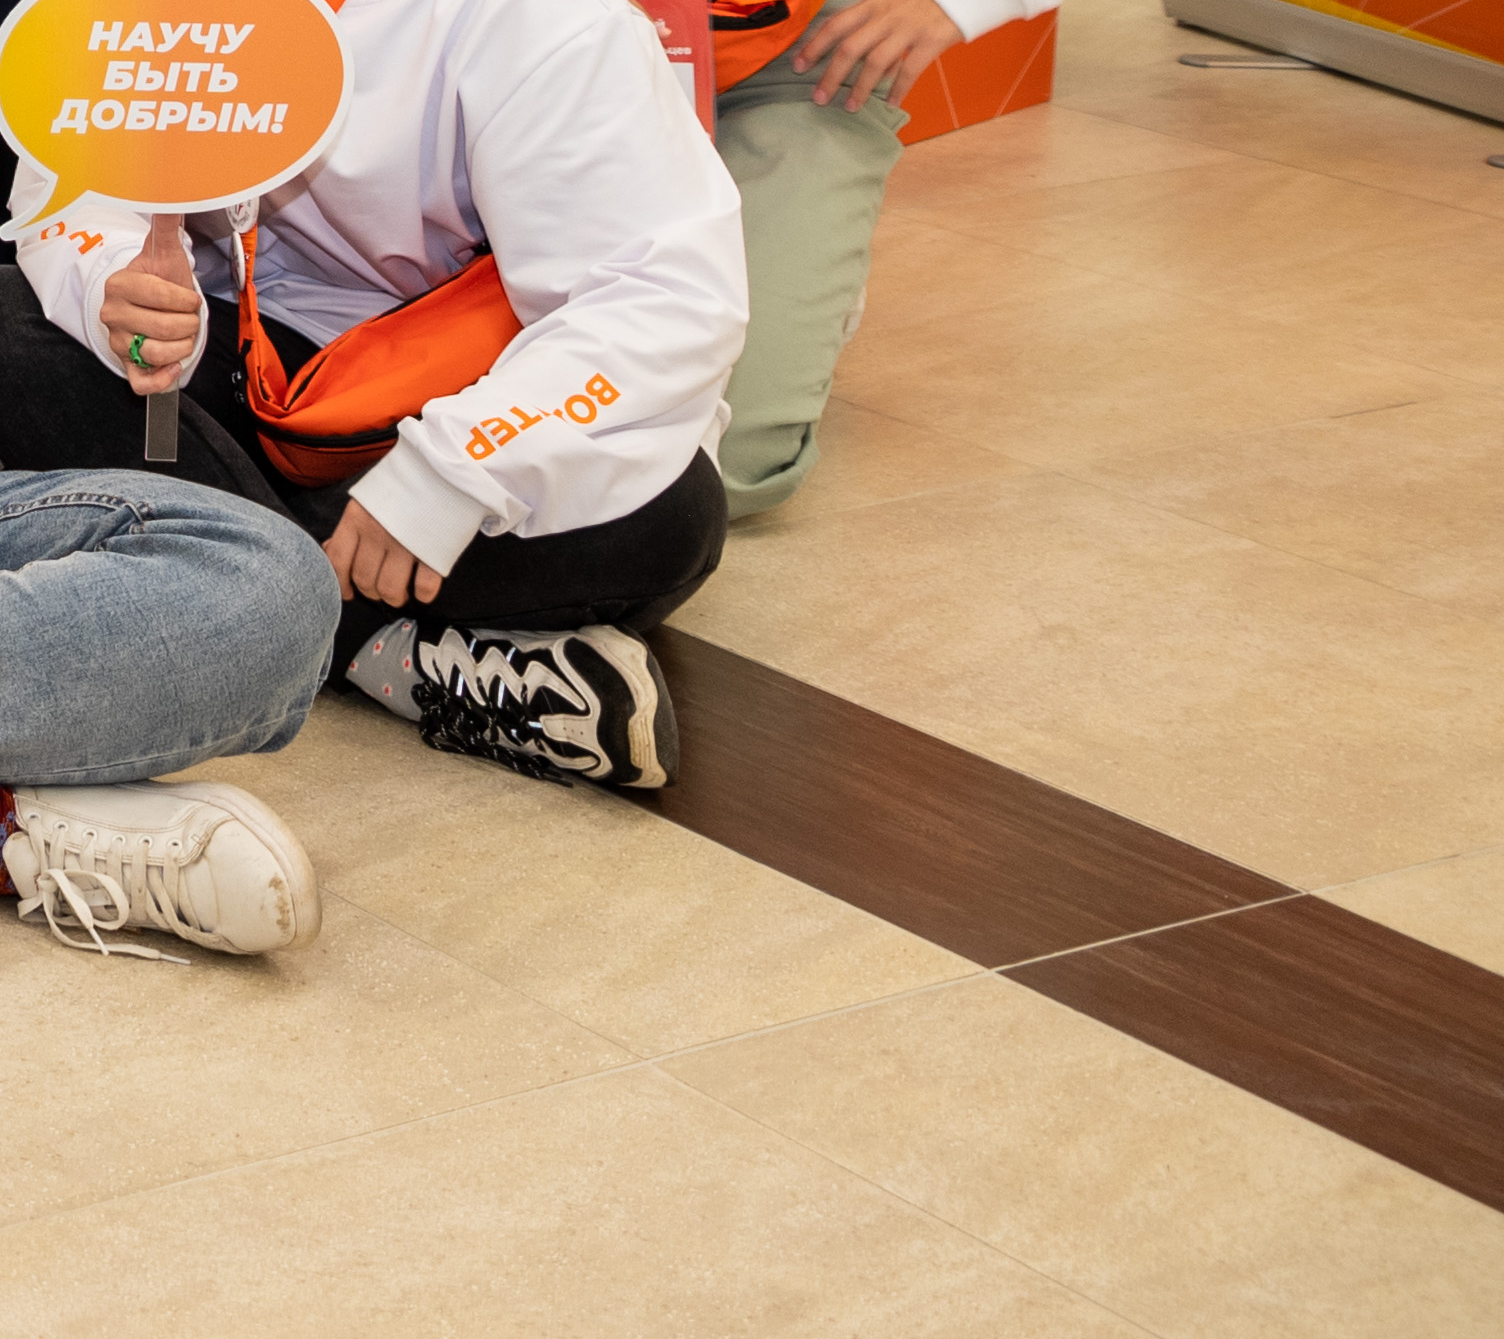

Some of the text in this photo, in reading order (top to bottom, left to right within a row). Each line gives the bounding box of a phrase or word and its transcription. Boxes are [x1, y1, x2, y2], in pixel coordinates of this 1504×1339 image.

[87, 19, 256, 57] НАУЧУ
[102, 60, 239, 94] БЫТЬ
[49, 98, 288, 137] ДОБРЫМ!
[464, 372, 622, 462] ВОТЕР
